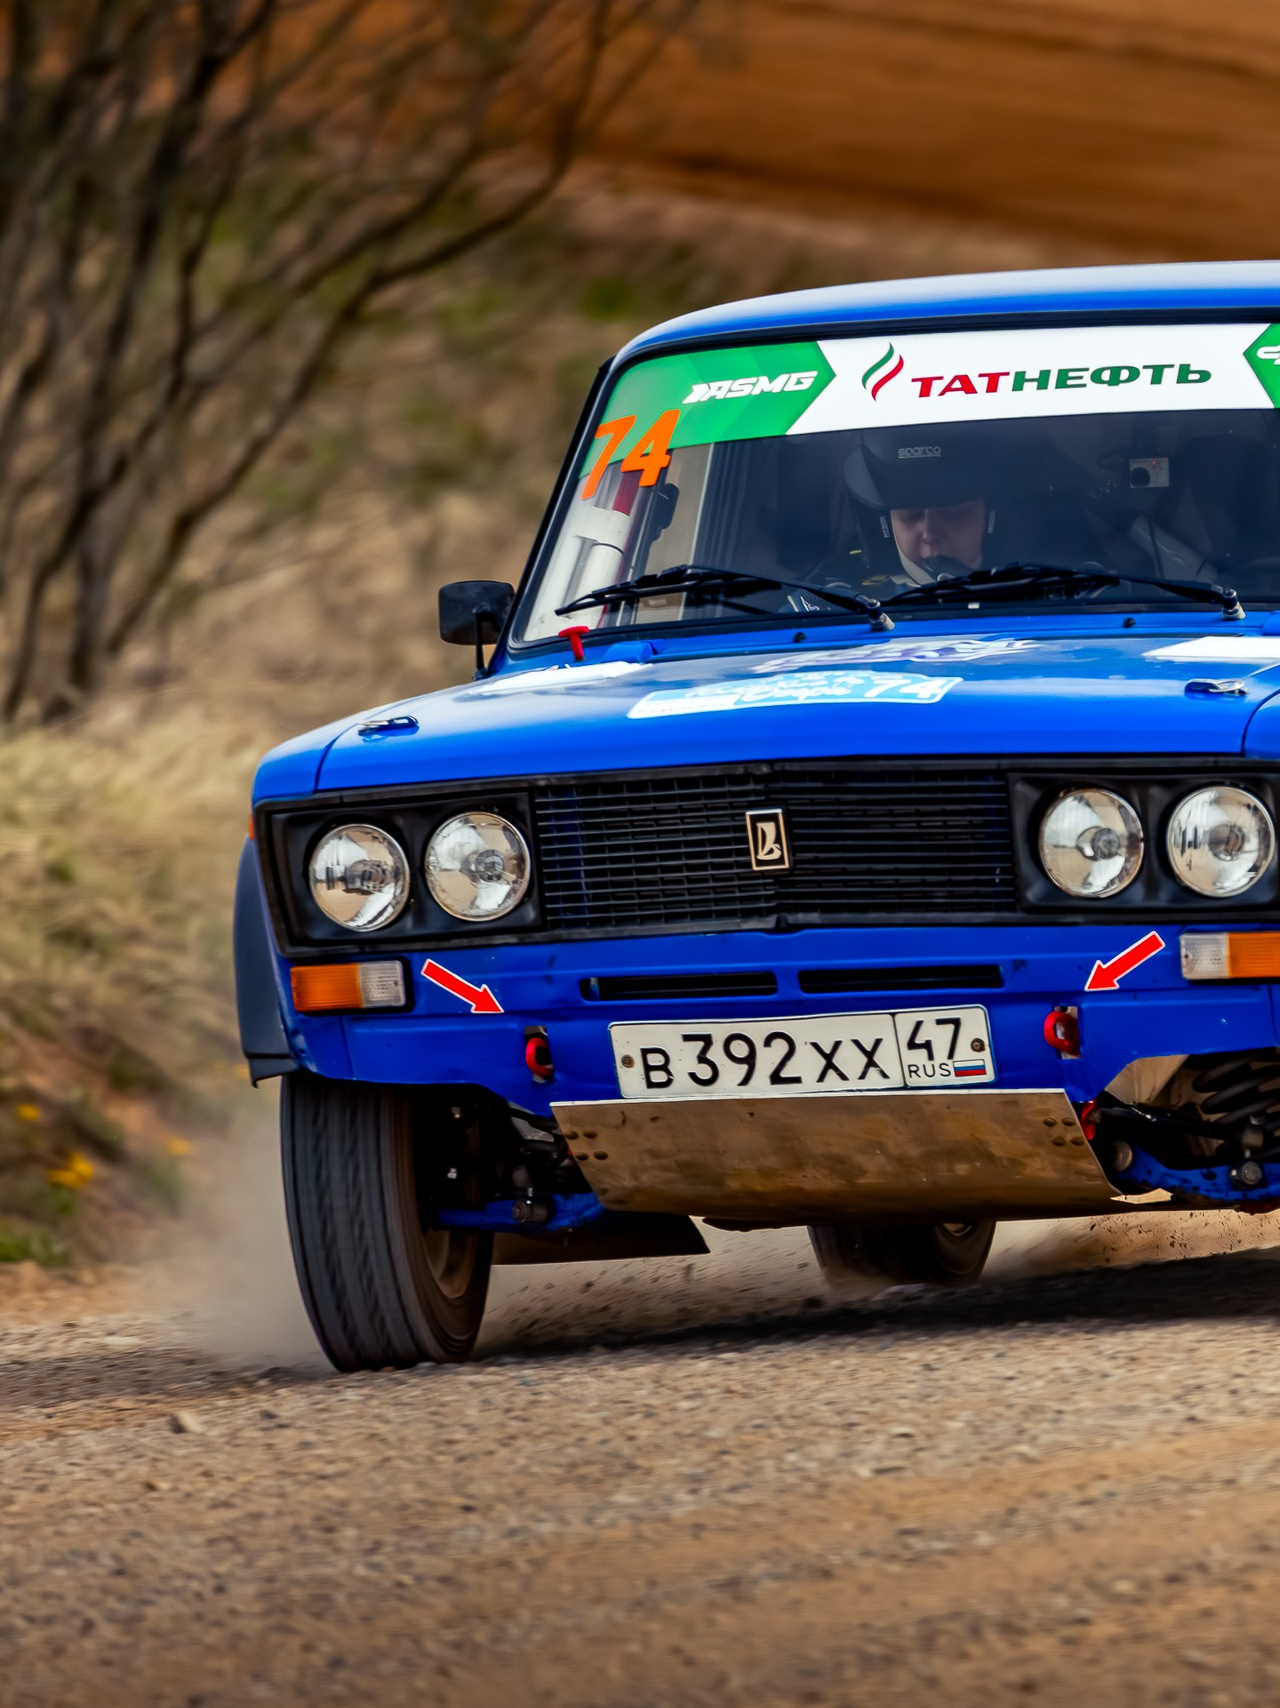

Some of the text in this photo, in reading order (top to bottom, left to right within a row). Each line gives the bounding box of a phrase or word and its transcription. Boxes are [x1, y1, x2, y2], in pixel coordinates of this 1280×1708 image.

[911, 363, 1212, 398] ТАТНЕФТЬ
[581, 409, 681, 500] 74
[863, 679, 948, 698] 74
[907, 1017, 962, 1061] 47
[909, 1062, 951, 1079] RUS
